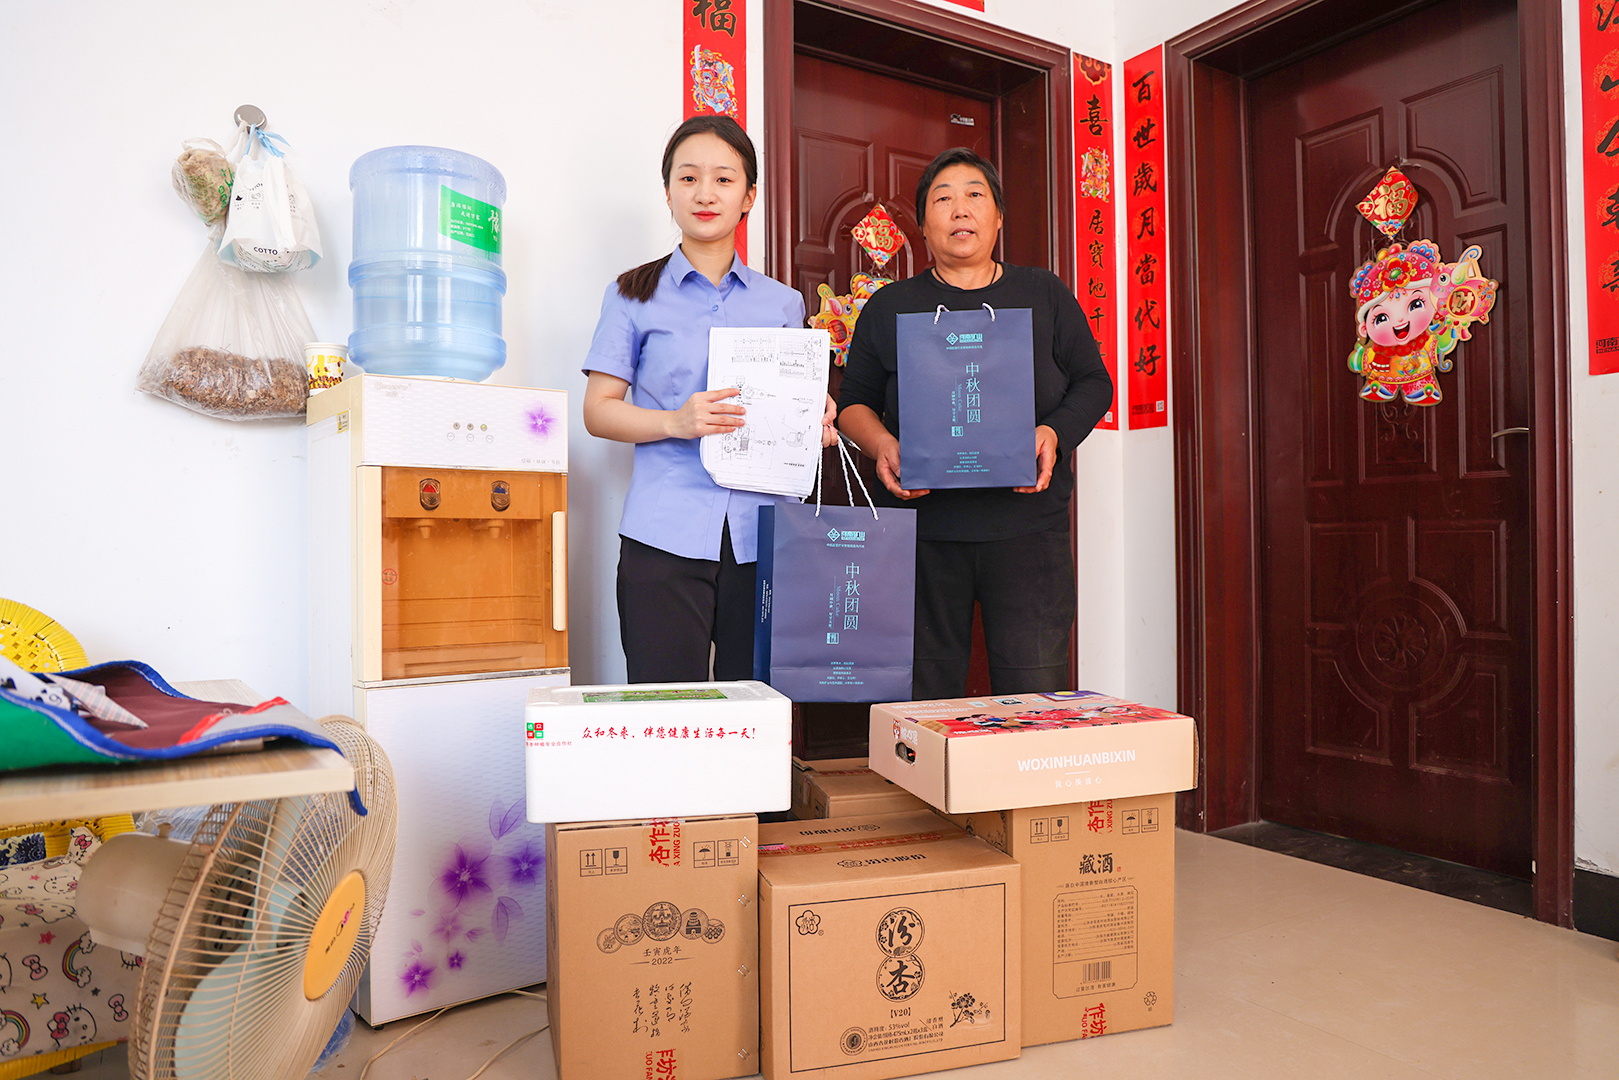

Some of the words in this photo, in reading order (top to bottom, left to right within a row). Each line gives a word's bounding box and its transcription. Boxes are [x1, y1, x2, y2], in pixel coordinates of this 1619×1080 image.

[692, 0, 737, 38] 福
[1374, 180, 1409, 220] 福
[866, 215, 894, 251] 福
[1132, 70, 1161, 376] 百世歲月當代好
[1088, 209, 1106, 357] 居寶地千
[965, 361, 981, 424] 中秋团圆
[844, 562, 861, 631] 中秋团圆
[1017, 749, 1136, 772] WOXINHUANBIXIN
[1054, 776, 1102, 788] 我心换彼心
[673, 840, 681, 859] XING
[1079, 852, 1114, 875] 藏酒
[643, 945, 682, 958] 壬寅虎年
[651, 956, 673, 966] 2022
[1088, 1002, 1107, 1038] 作坊
